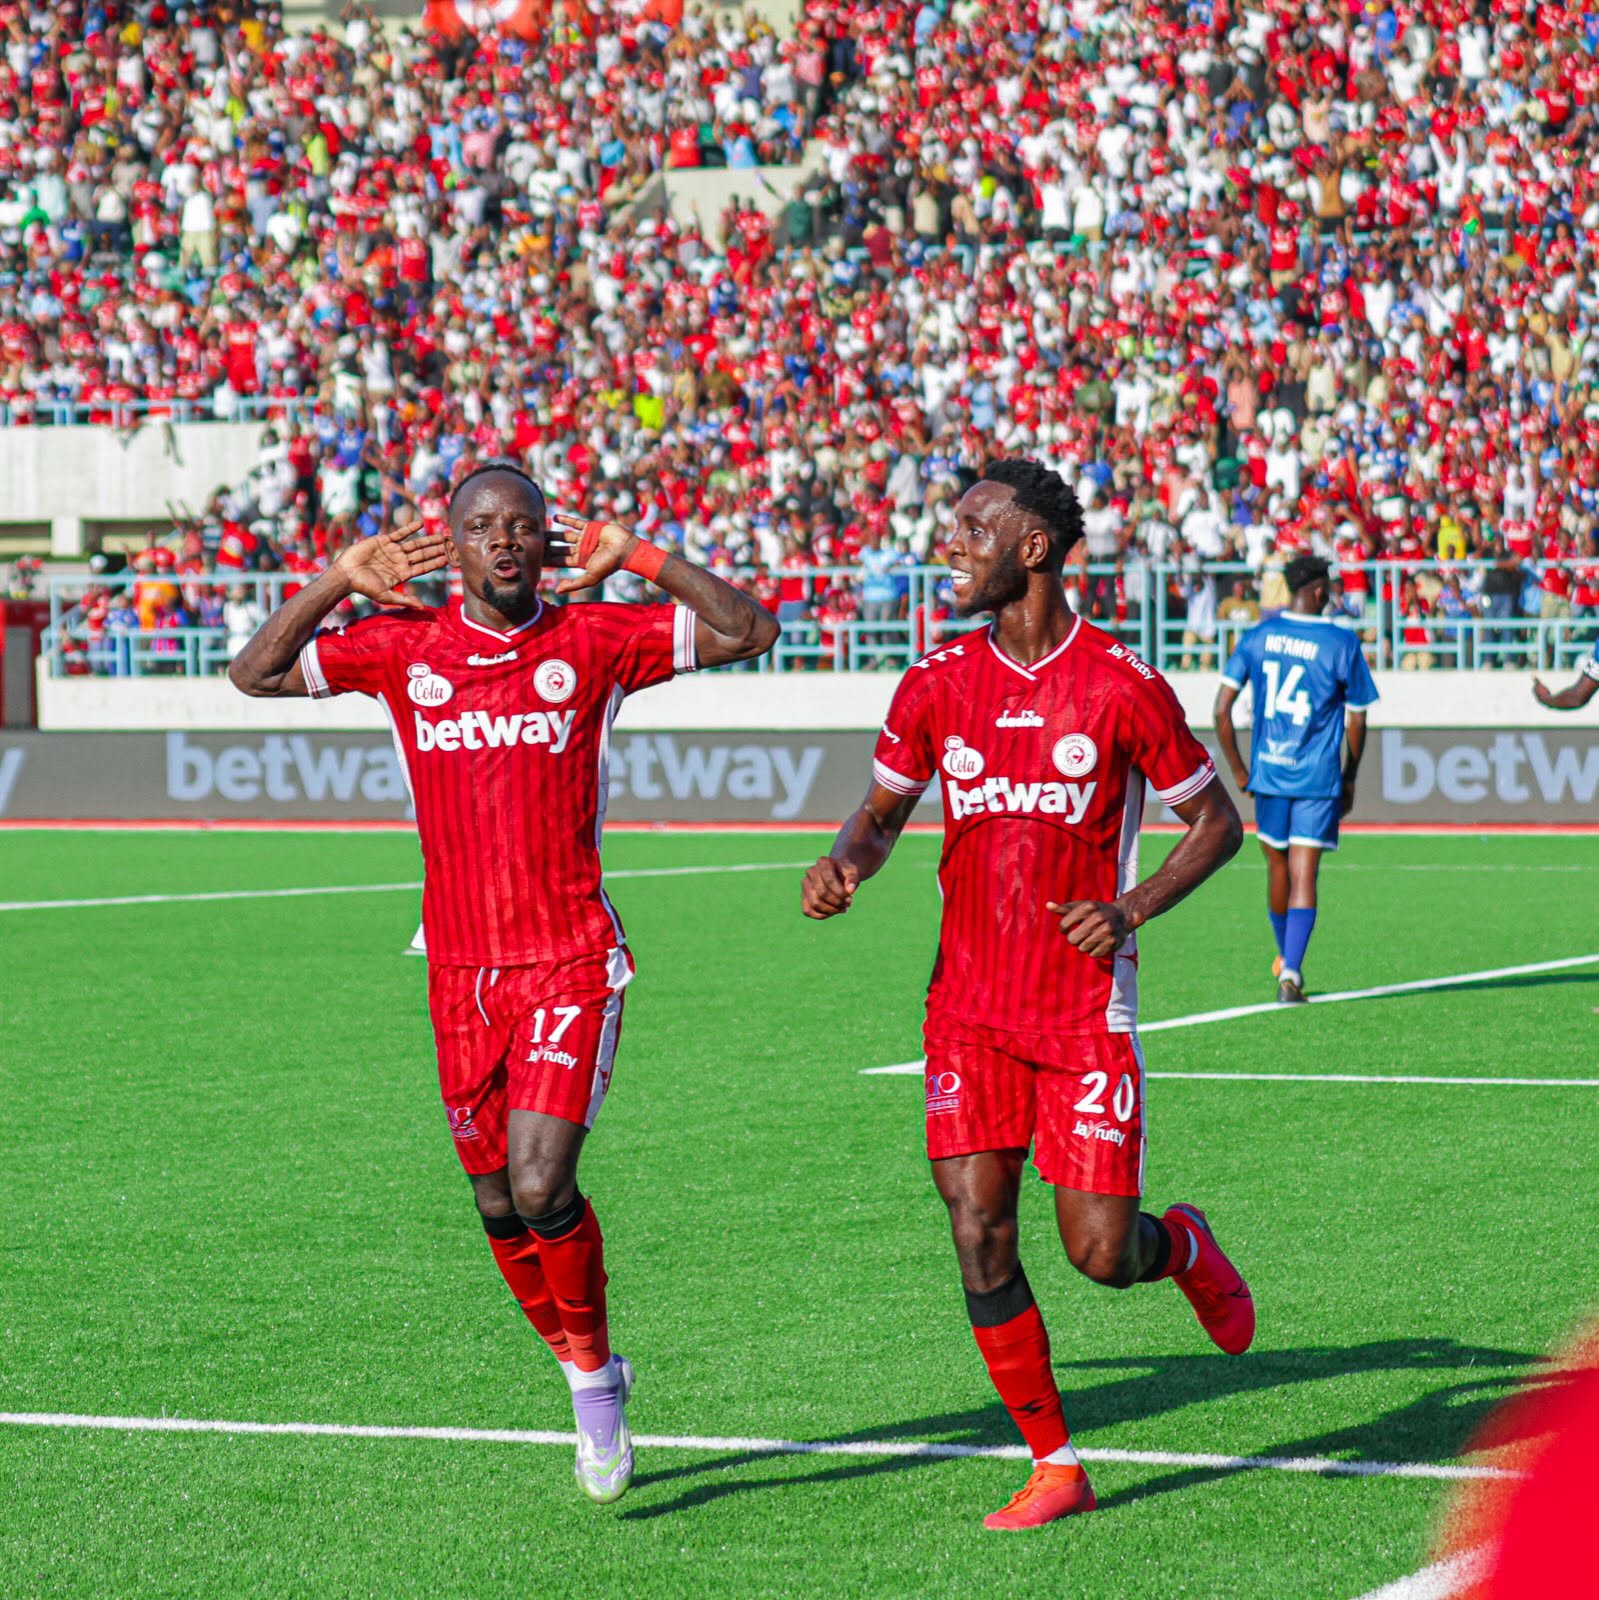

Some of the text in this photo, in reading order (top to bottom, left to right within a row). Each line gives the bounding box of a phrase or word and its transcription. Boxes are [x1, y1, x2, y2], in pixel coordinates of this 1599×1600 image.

[414, 679, 444, 700] Cola
[1262, 660, 1312, 726] 14
[413, 709, 577, 754] betway
[165, 732, 418, 820] betwa
[949, 752, 976, 773] Cola
[946, 776, 1098, 825] betway
[530, 1005, 581, 1043] 17
[1073, 1070, 1134, 1122] 20
